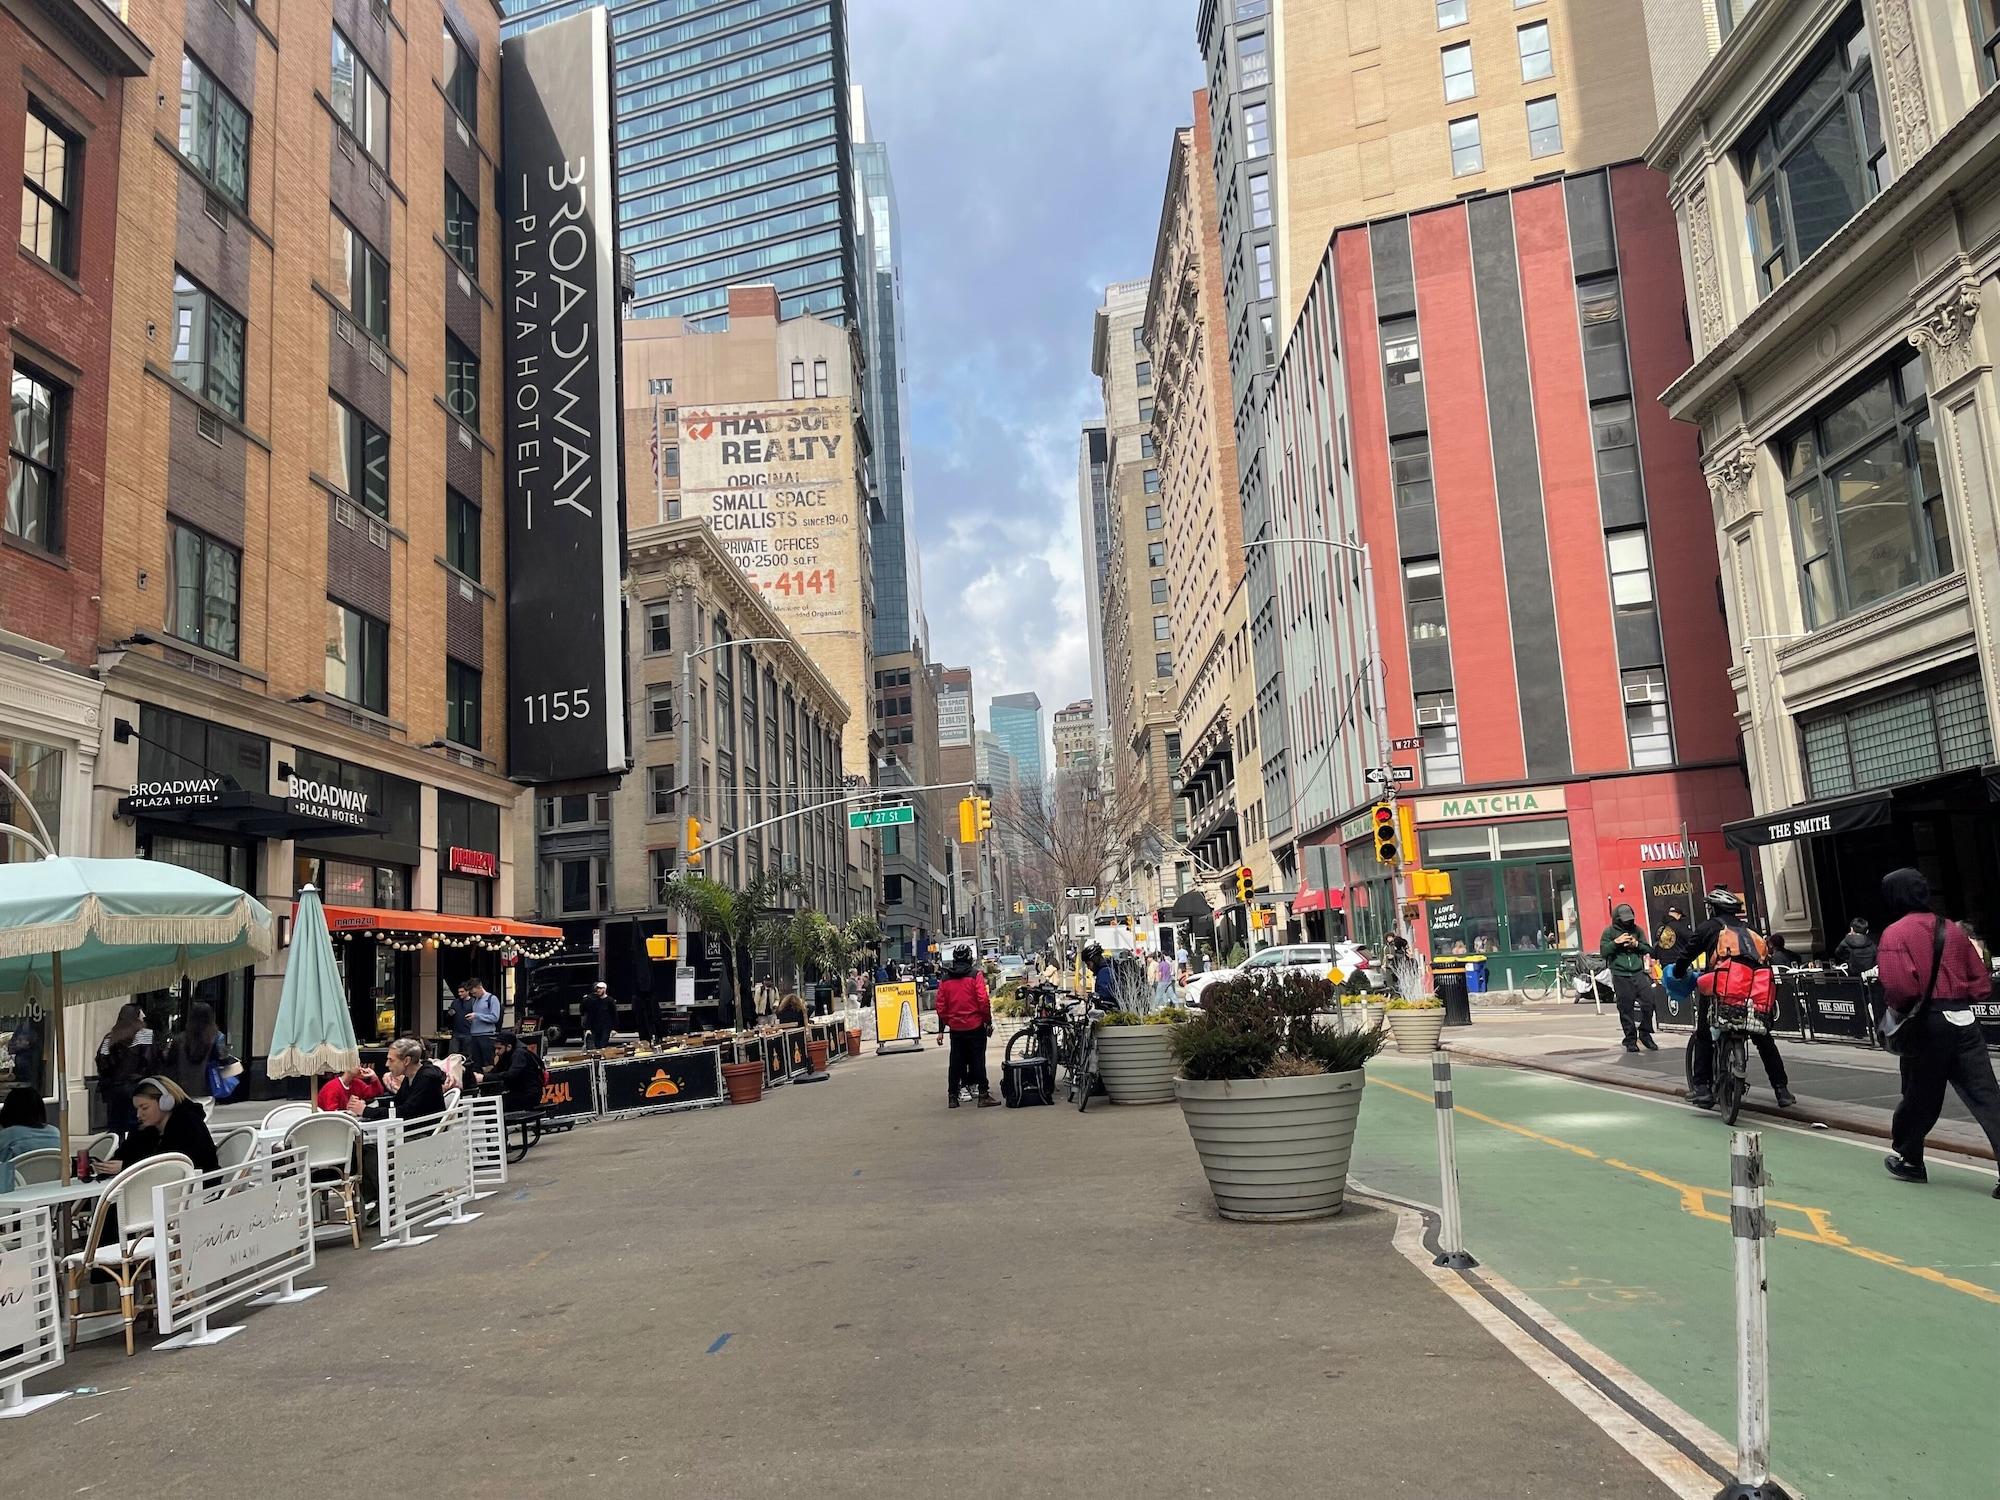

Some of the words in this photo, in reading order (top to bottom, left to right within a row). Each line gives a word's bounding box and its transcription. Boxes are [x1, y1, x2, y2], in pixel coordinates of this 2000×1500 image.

[515, 214, 538, 340] PLAZA
[548, 155, 592, 518] BROADWAY
[516, 355, 540, 488] HOTEL
[722, 435, 841, 465] REALTY
[713, 493, 768, 512] SMALL
[775, 490, 827, 508] SPACE
[705, 511, 797, 531] PECIALISTS
[724, 540, 768, 554] PRIVATE
[774, 537, 819, 552] OFFICES
[523, 688, 591, 725] 1155
[1395, 741, 1403, 750] W
[1402, 740, 1412, 749] 27
[1372, 771, 1384, 779] ON
[129, 778, 219, 797] BROADWAY
[287, 773, 368, 813] BROADWAY
[135, 797, 171, 807] PLAZA
[175, 794, 212, 805] HOTEL
[1442, 793, 1539, 817] MATCHA
[299, 802, 330, 818] PLAZA
[331, 809, 360, 825] HOTEL
[863, 814, 872, 824] W
[876, 812, 886, 823] 27
[889, 811, 898, 822] St
[1768, 822, 1792, 840] THE
[1793, 814, 1832, 835] SMITH
[1640, 840, 1699, 861] PASTAGAM
[1435, 915, 1448, 923] YOU
[1448, 912, 1457, 920] SO
[1438, 904, 1454, 914] LOVE
[1817, 1002, 1833, 1012] THE
[1833, 1002, 1856, 1013] SMITH
[1968, 1004, 1988, 1015] THE
[229, 1243, 260, 1266] MIAMI
